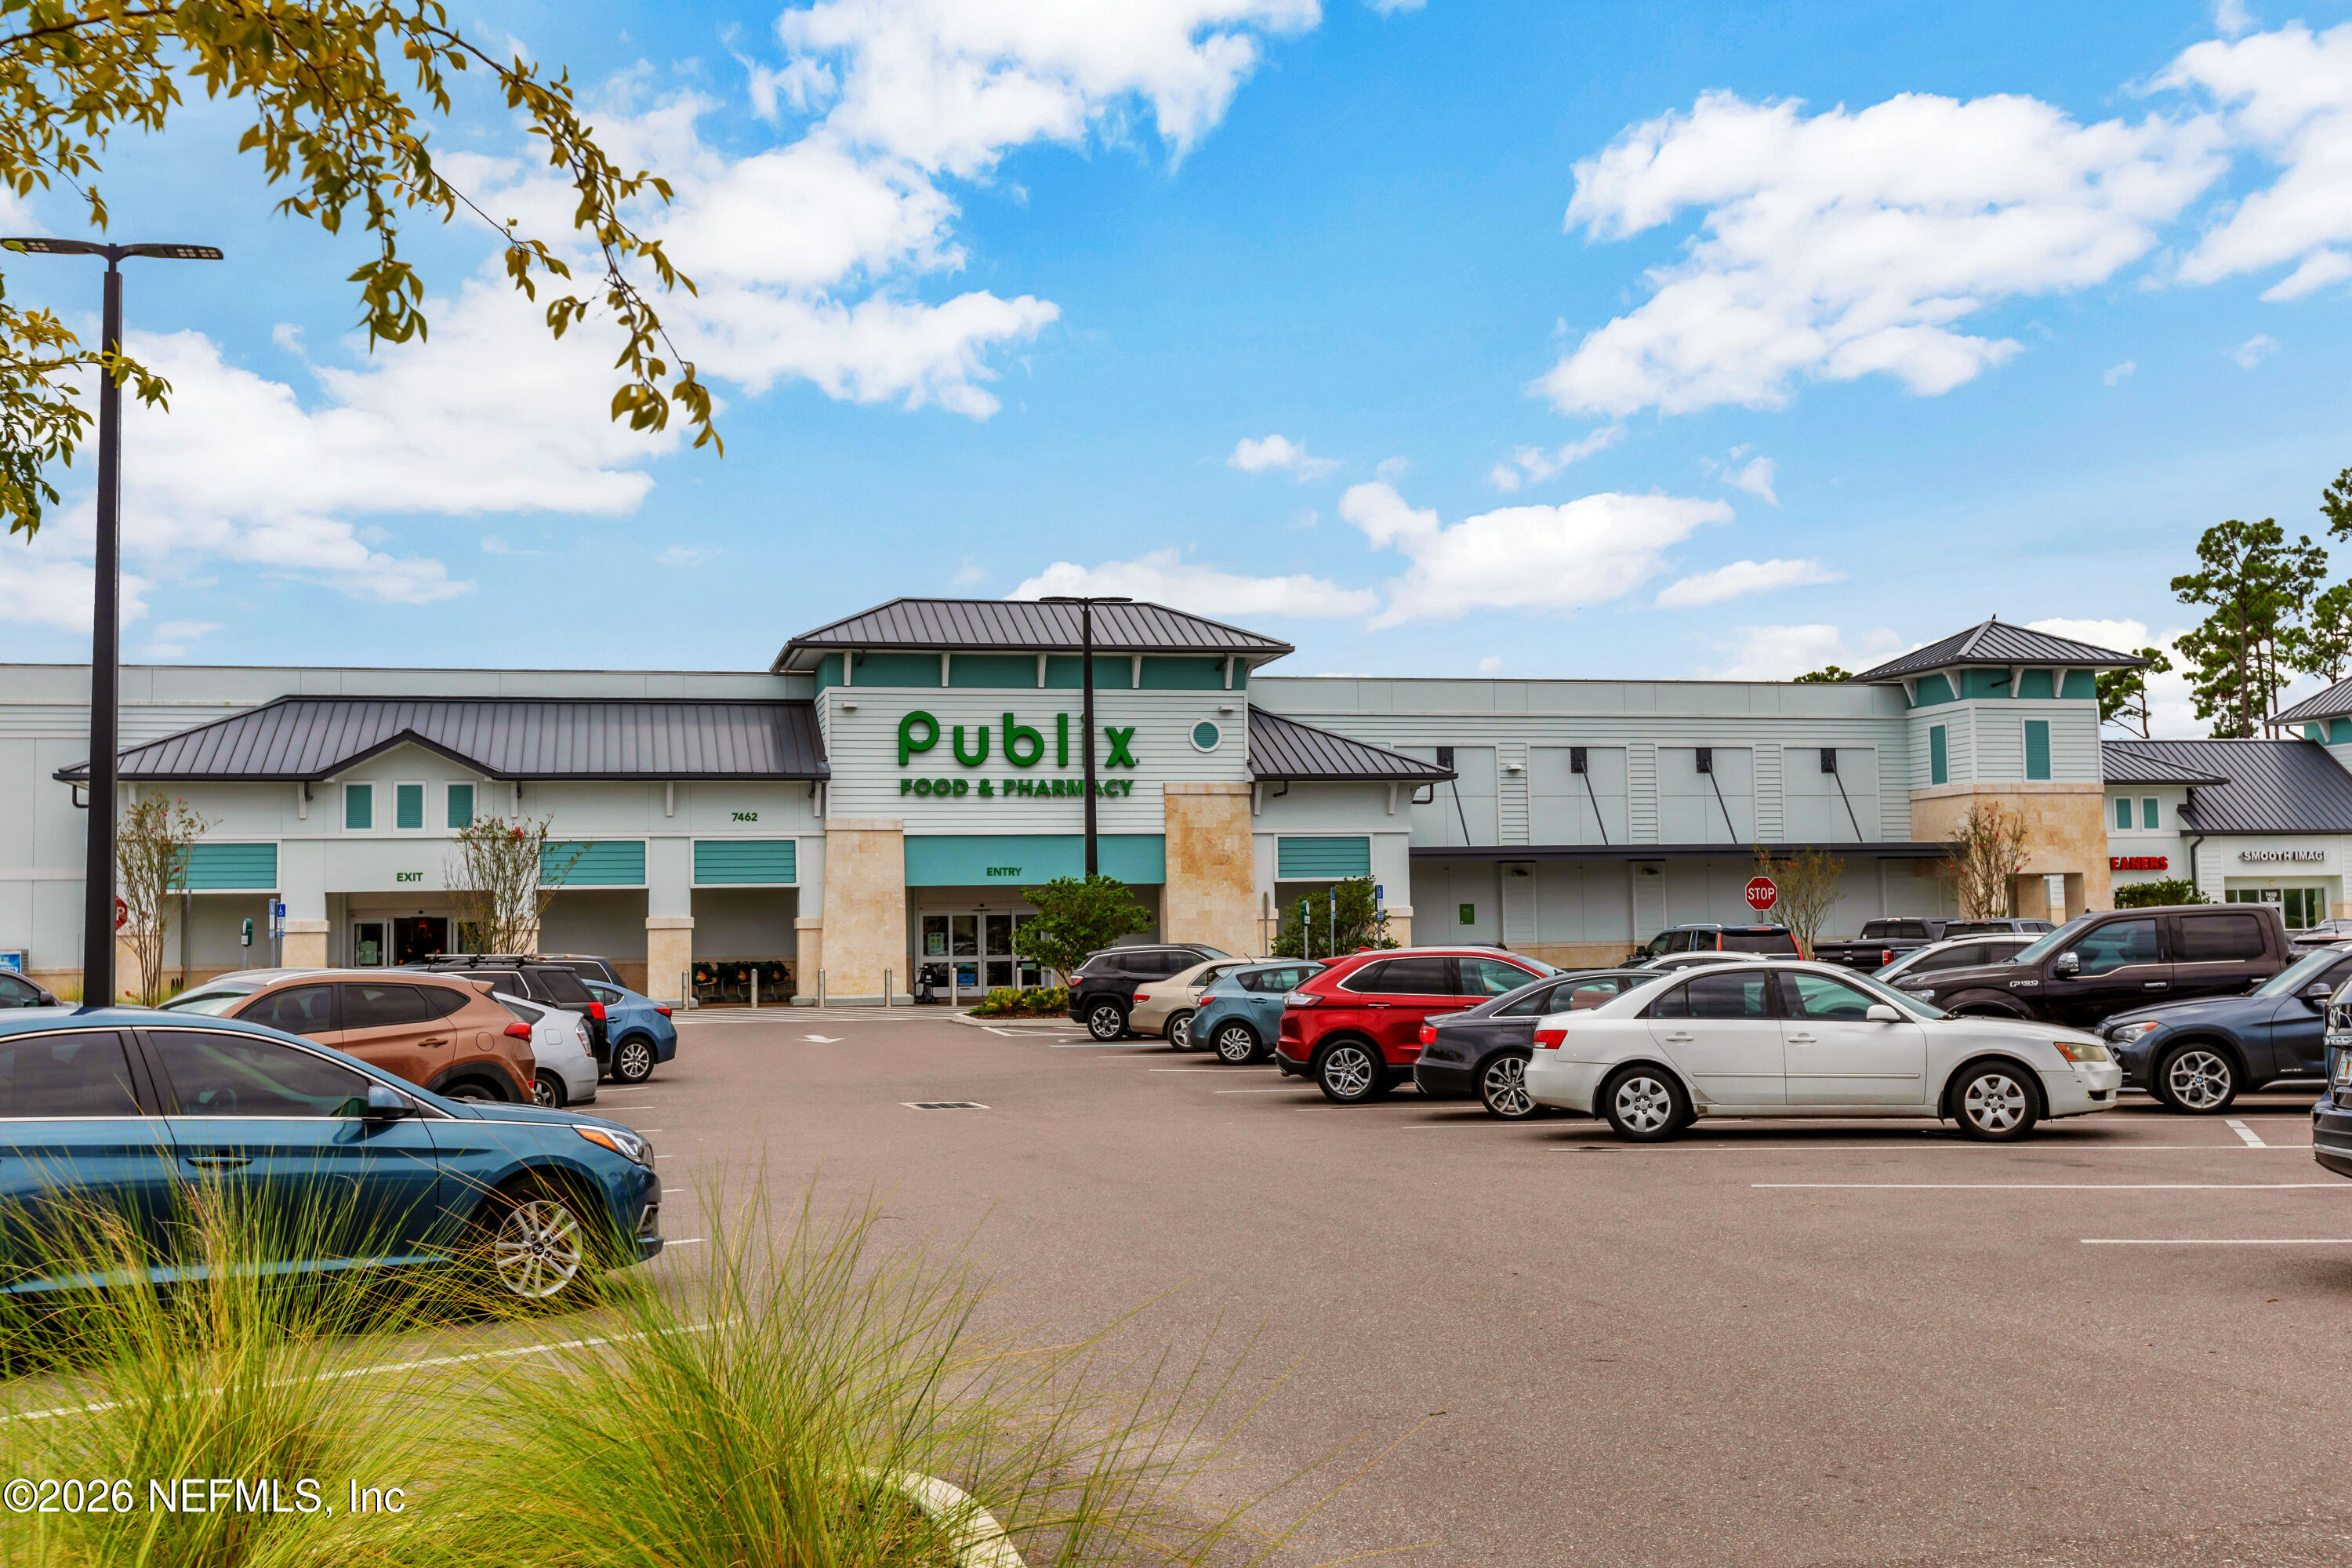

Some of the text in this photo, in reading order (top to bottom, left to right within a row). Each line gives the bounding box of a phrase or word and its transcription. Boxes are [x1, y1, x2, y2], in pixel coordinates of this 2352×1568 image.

[898, 710, 1136, 767] Publx
[901, 779, 969, 797] FOOD
[978, 779, 994, 797] &
[731, 812, 758, 822] 7462
[2244, 851, 2292, 861] SMOOTH
[397, 872, 423, 882] EXIT
[986, 867, 1022, 877] ENTRY
[1748, 887, 1775, 900] STOP
